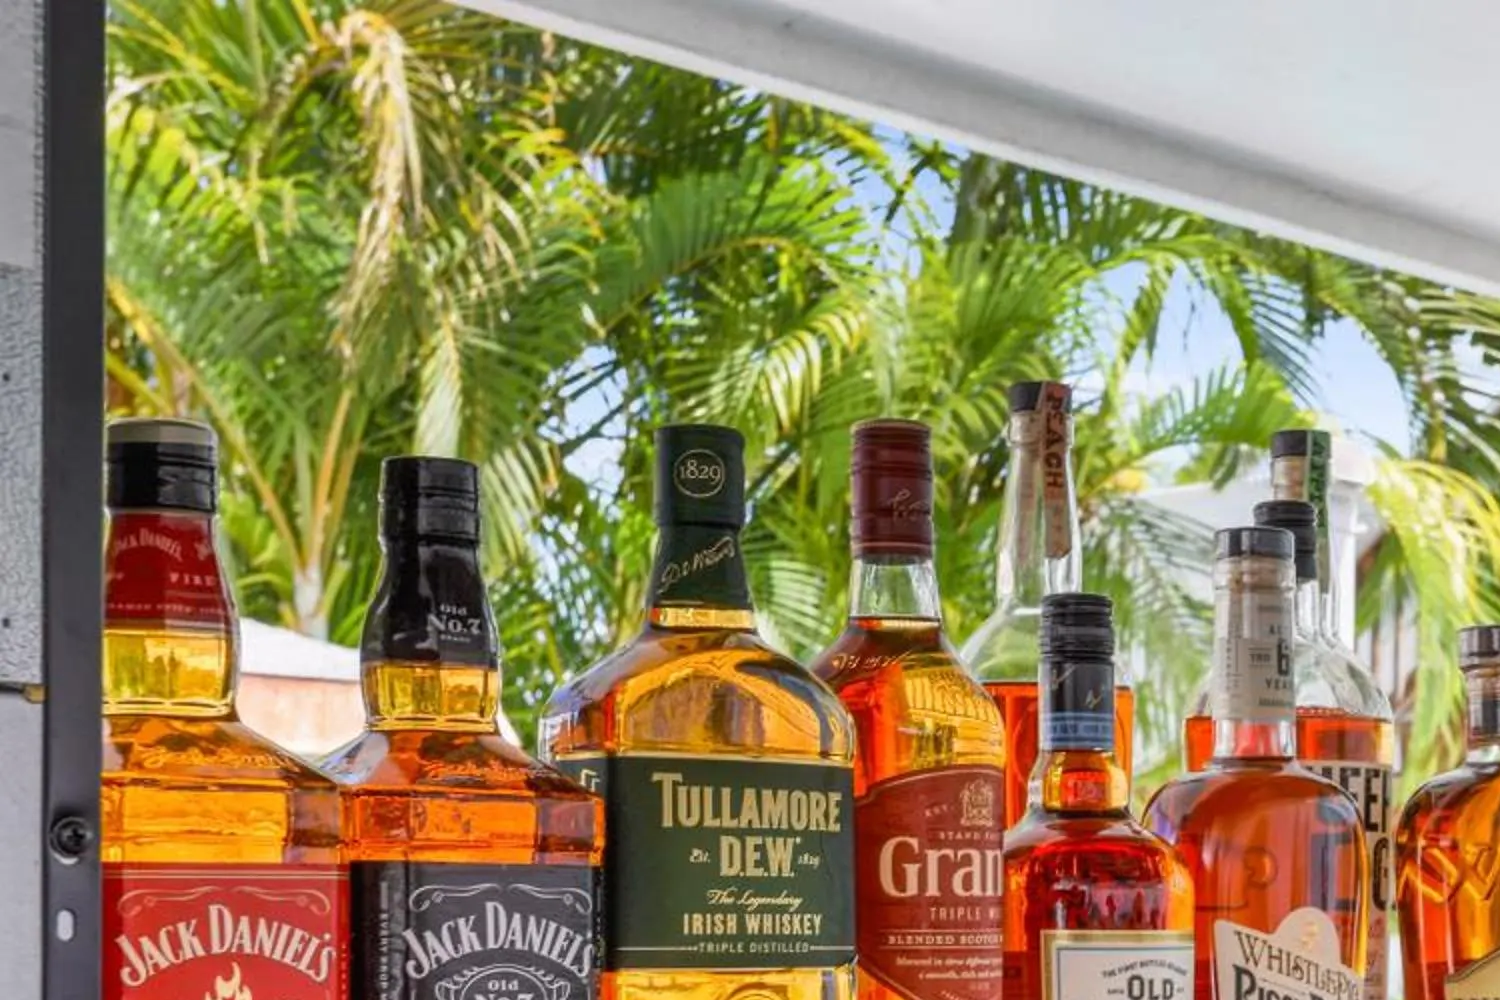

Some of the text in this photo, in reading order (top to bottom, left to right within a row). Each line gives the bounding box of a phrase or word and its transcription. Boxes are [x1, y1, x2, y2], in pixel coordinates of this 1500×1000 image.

[680, 459, 720, 485] 1829
[440, 603, 467, 616] Old
[426, 612, 481, 635] No.7
[652, 772, 842, 832] TULLAMORE
[707, 887, 803, 912] The Legendary
[683, 913, 823, 936] IRISH WHISKEY
[929, 907, 980, 921] TRIPLE
[115, 904, 336, 987] JACK DANIEL'S
[403, 916, 482, 979] JACK
[699, 941, 811, 953] TRIPLE DISTILLED
[888, 935, 955, 945] BLENDED
[488, 979, 519, 991] Old
[1127, 974, 1174, 1000] OLD
